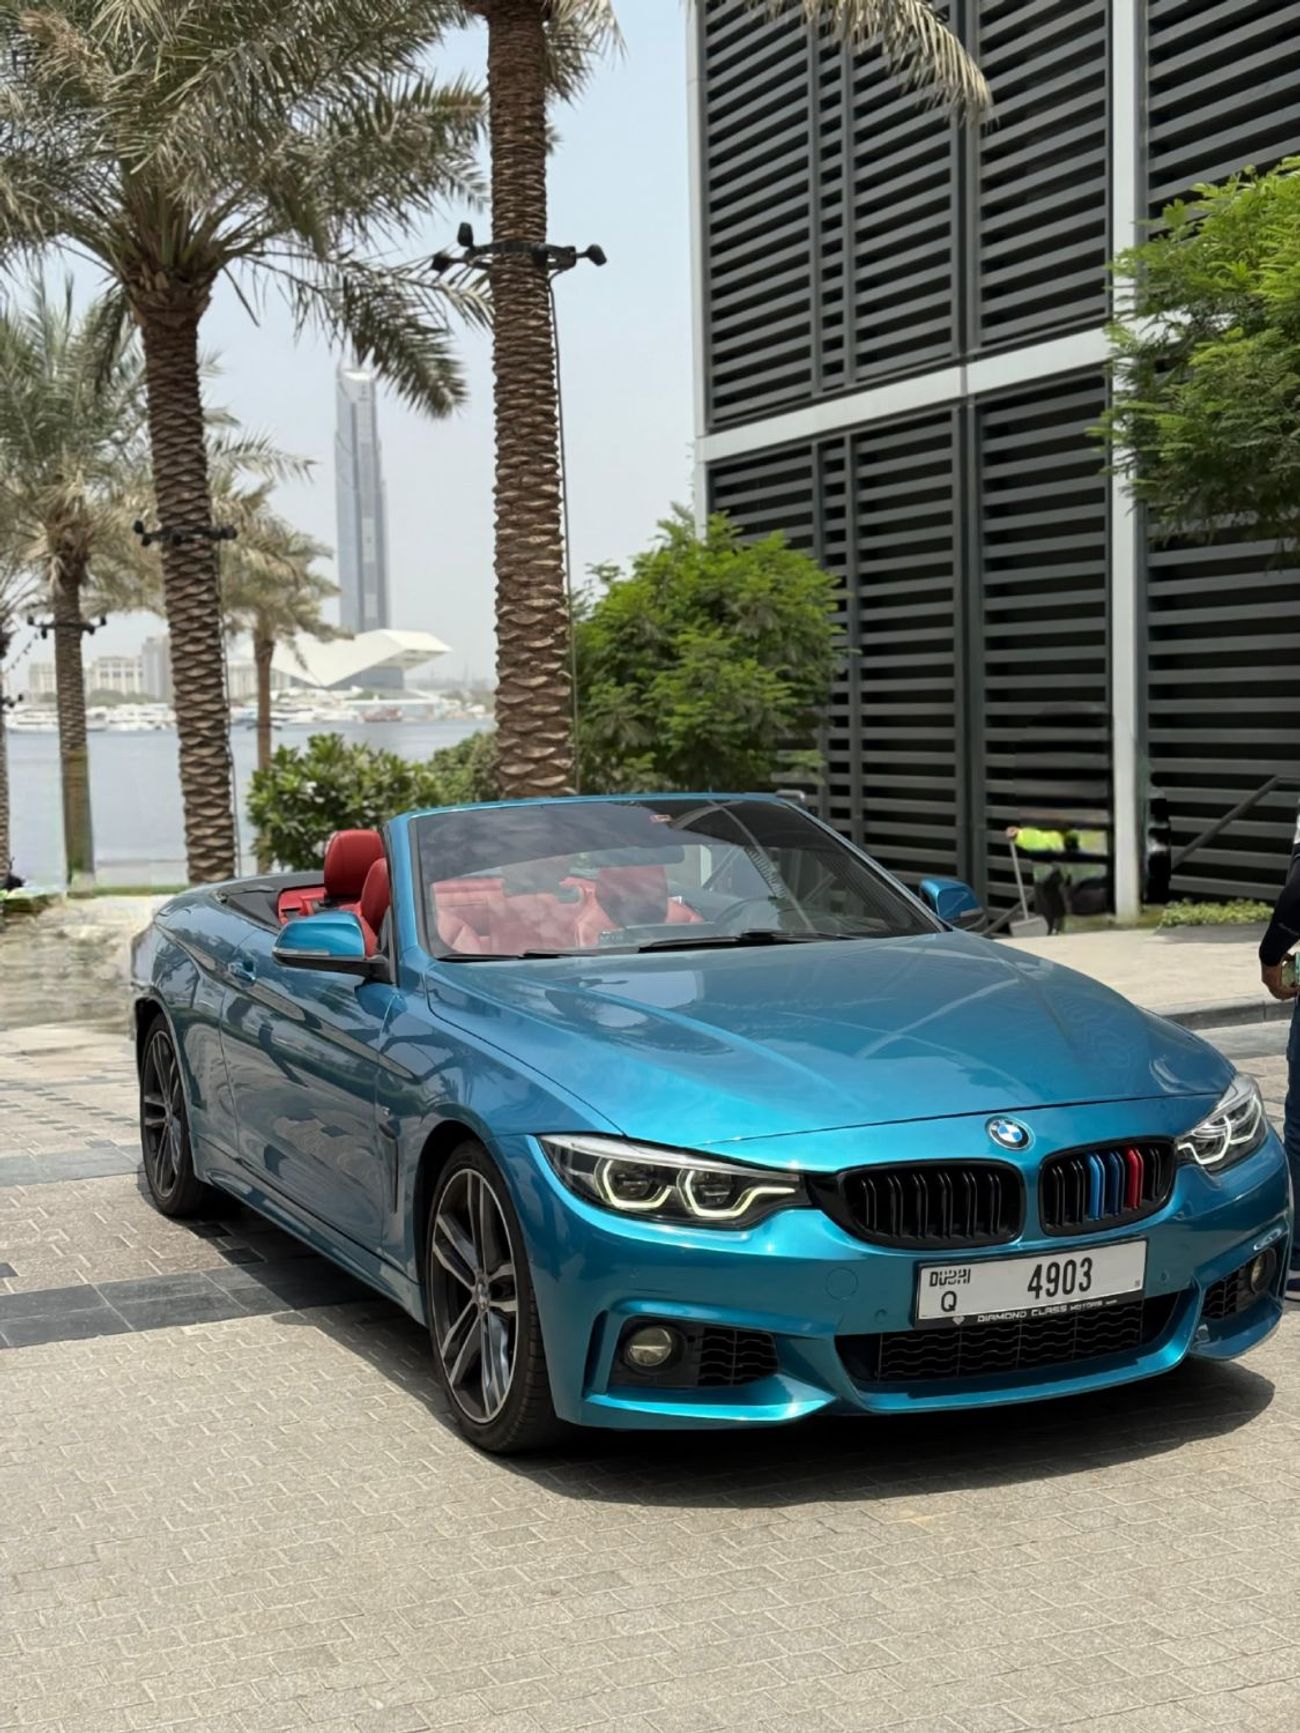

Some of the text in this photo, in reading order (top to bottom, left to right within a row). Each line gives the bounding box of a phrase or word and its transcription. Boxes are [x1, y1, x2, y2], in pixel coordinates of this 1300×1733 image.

[1027, 1257, 1093, 1299] 4903
[940, 1290, 957, 1312] Q
[977, 1310, 1027, 1322] DIAMOND
[1031, 1304, 1067, 1316] CLASS
